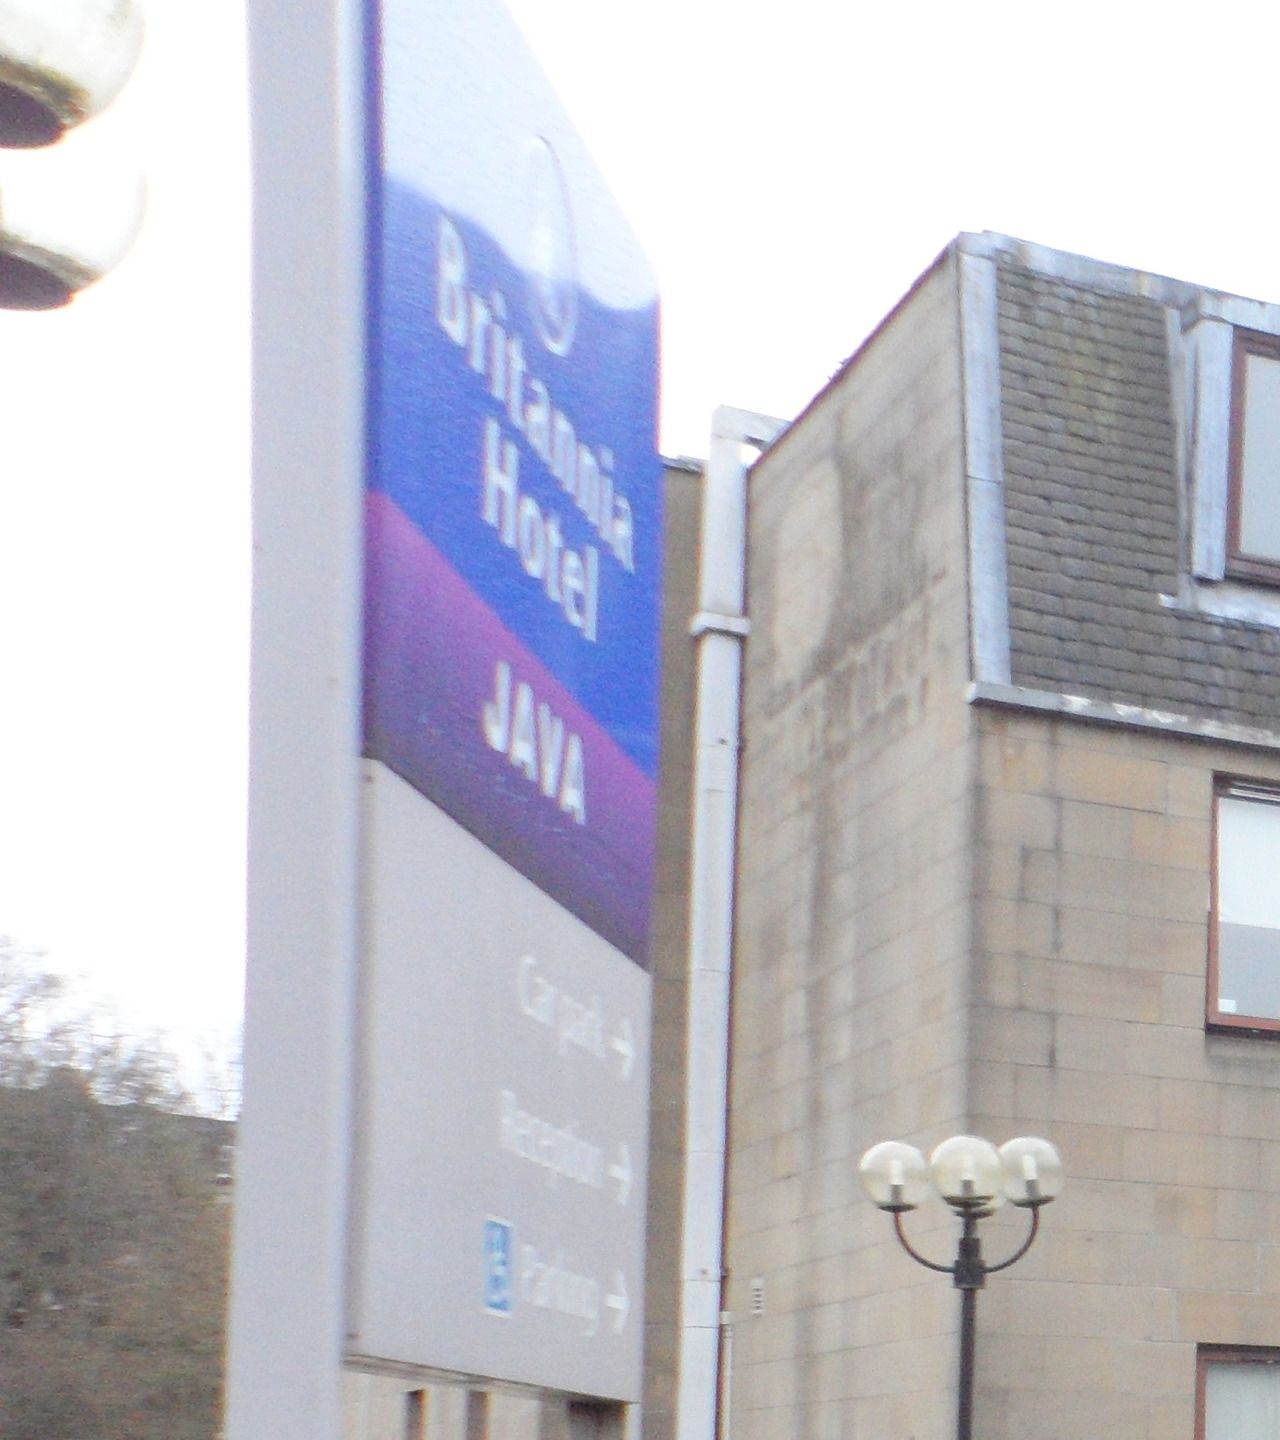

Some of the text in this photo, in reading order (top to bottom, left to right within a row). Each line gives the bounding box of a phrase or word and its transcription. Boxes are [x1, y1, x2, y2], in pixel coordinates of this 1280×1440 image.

[437, 211, 634, 573] Britannia
[483, 418, 599, 643] Hotel
[483, 660, 586, 826] JAVA
